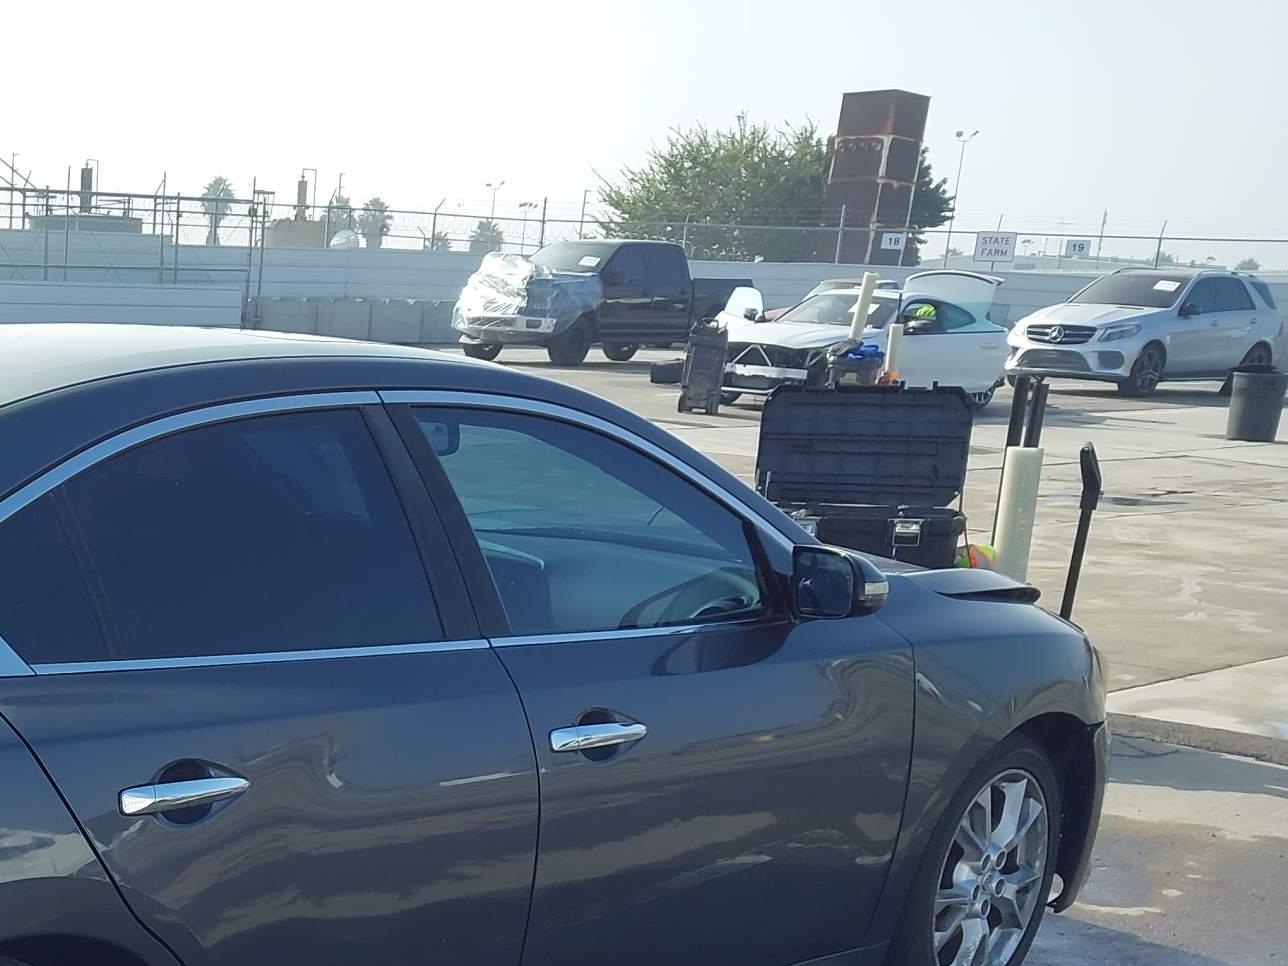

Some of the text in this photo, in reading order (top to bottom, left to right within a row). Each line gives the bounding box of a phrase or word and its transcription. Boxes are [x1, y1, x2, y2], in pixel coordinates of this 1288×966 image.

[888, 237, 900, 246] 18
[982, 236, 1011, 246] STATE
[980, 247, 1008, 257] FARM
[1072, 243, 1085, 252] 19
